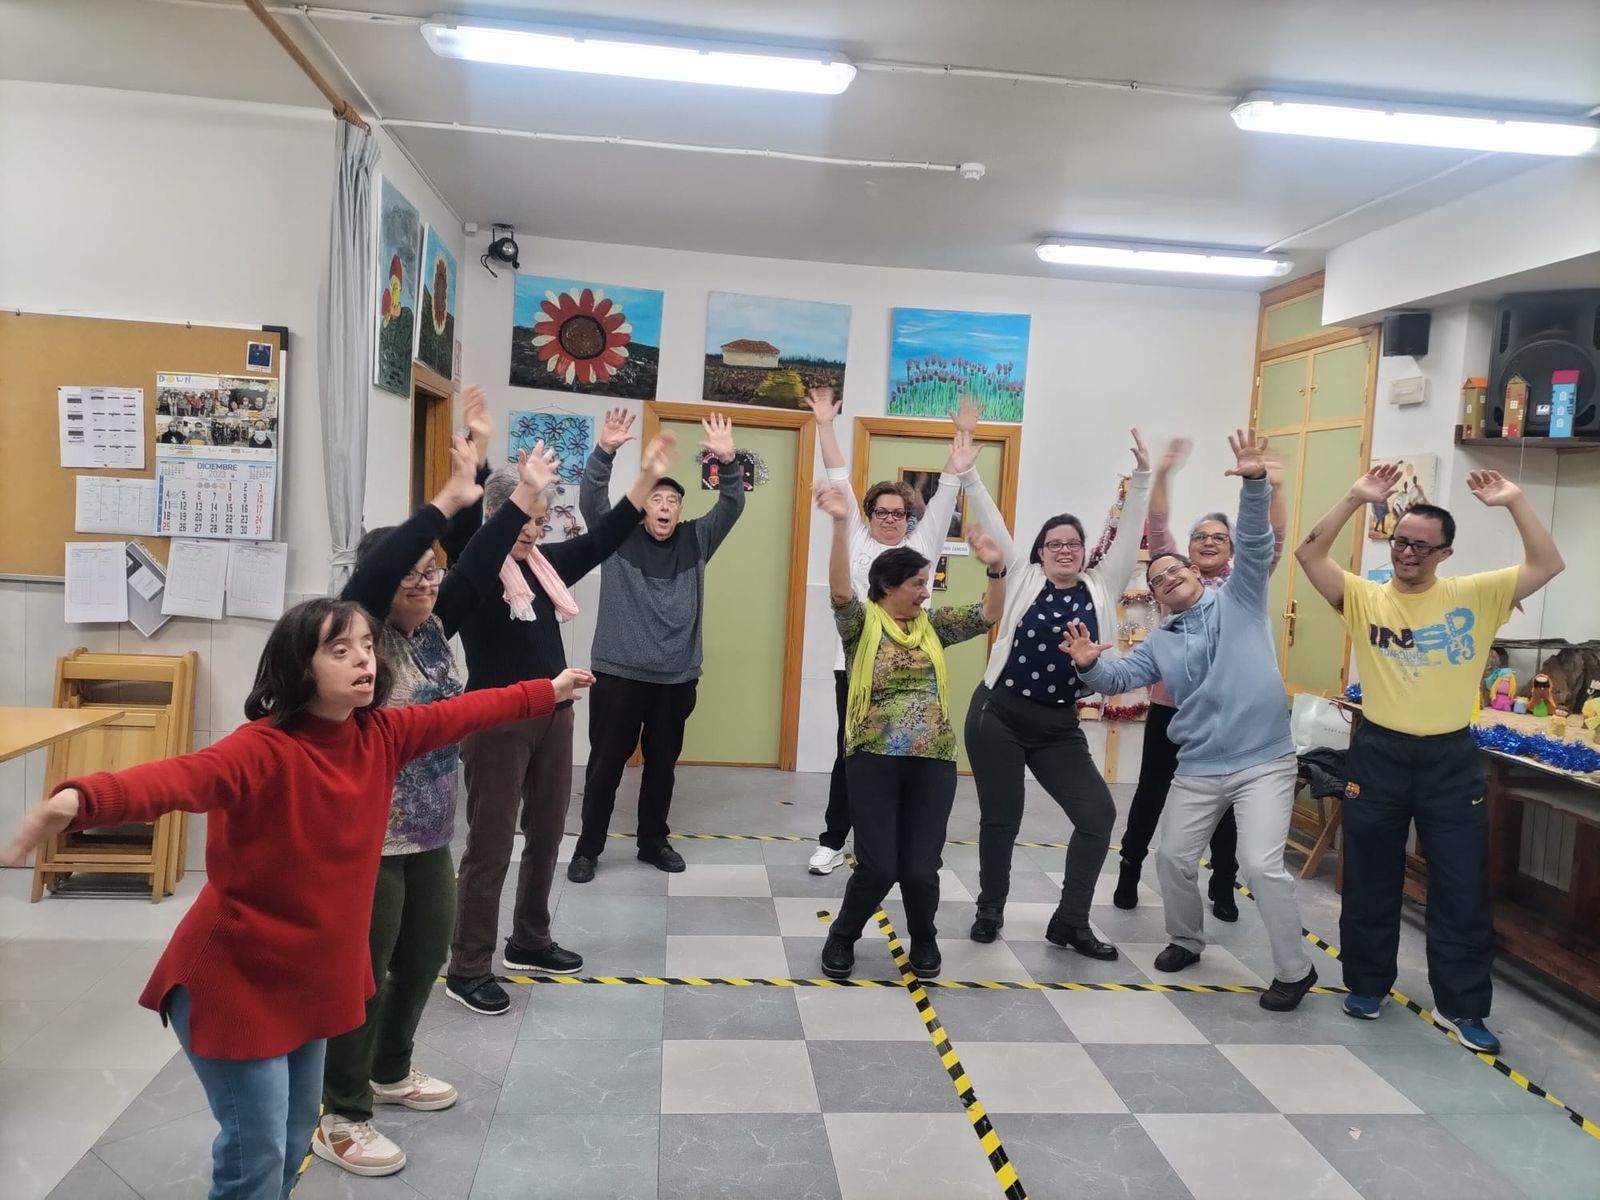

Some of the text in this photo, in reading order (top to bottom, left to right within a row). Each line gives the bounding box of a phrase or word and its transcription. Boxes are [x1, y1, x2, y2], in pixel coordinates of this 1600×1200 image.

[197, 463, 238, 471] DICIEMBRE
[208, 470, 226, 478] 2023
[228, 482, 232, 491] 1
[166, 490, 170, 499] 4
[182, 491, 186, 500] 5
[212, 492, 217, 501] 7
[164, 501, 171, 509] 11
[180, 502, 187, 510] 12
[196, 502, 203, 511] 13
[211, 503, 217, 511] 14
[226, 504, 233, 512] 15
[242, 504, 248, 513] 16
[164, 512, 171, 520] 18
[179, 512, 186, 521] 19
[195, 513, 202, 522] 20
[211, 514, 217, 522] 21
[226, 514, 233, 523] 22
[241, 515, 248, 524] 23
[179, 522, 186, 532] 26
[195, 523, 202, 532] 27
[210, 524, 217, 533] 28
[225, 524, 232, 534] 29
